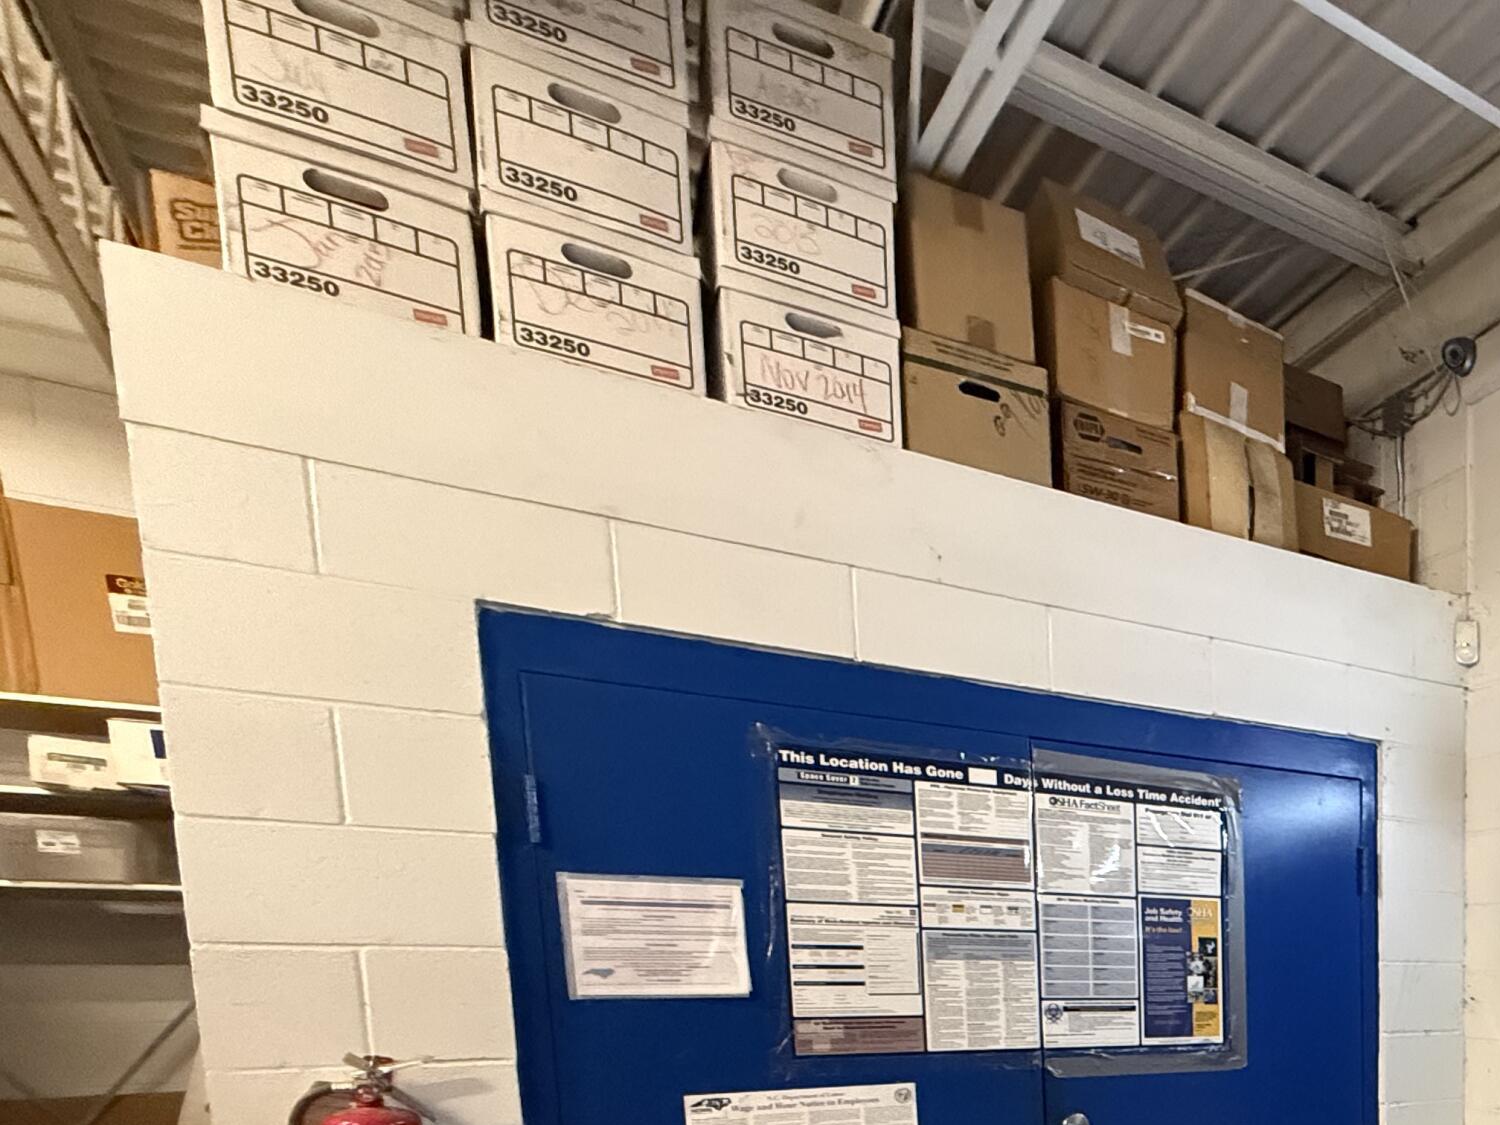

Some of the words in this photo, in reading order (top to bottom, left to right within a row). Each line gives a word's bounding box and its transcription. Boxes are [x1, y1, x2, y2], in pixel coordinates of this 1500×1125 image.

[492, 4, 567, 43] 33250
[240, 83, 330, 124] 33250
[734, 100, 796, 132] 33250
[505, 166, 578, 202] 33250
[739, 245, 801, 275] 33250
[253, 260, 341, 297] 33250
[519, 326, 591, 357] 33250
[749, 389, 809, 415] 33250
[818, 374, 868, 415] 2014
[778, 750, 815, 765] This
[819, 754, 889, 772] Location
[892, 762, 922, 776] Has
[925, 766, 964, 780] Gone
[1004, 773, 1038, 790] Days
[1041, 777, 1091, 794] Without
[1094, 785, 1103, 795] a
[1106, 786, 1134, 799] Loss
[1137, 789, 1167, 802] Time
[1170, 792, 1221, 807] Accident
